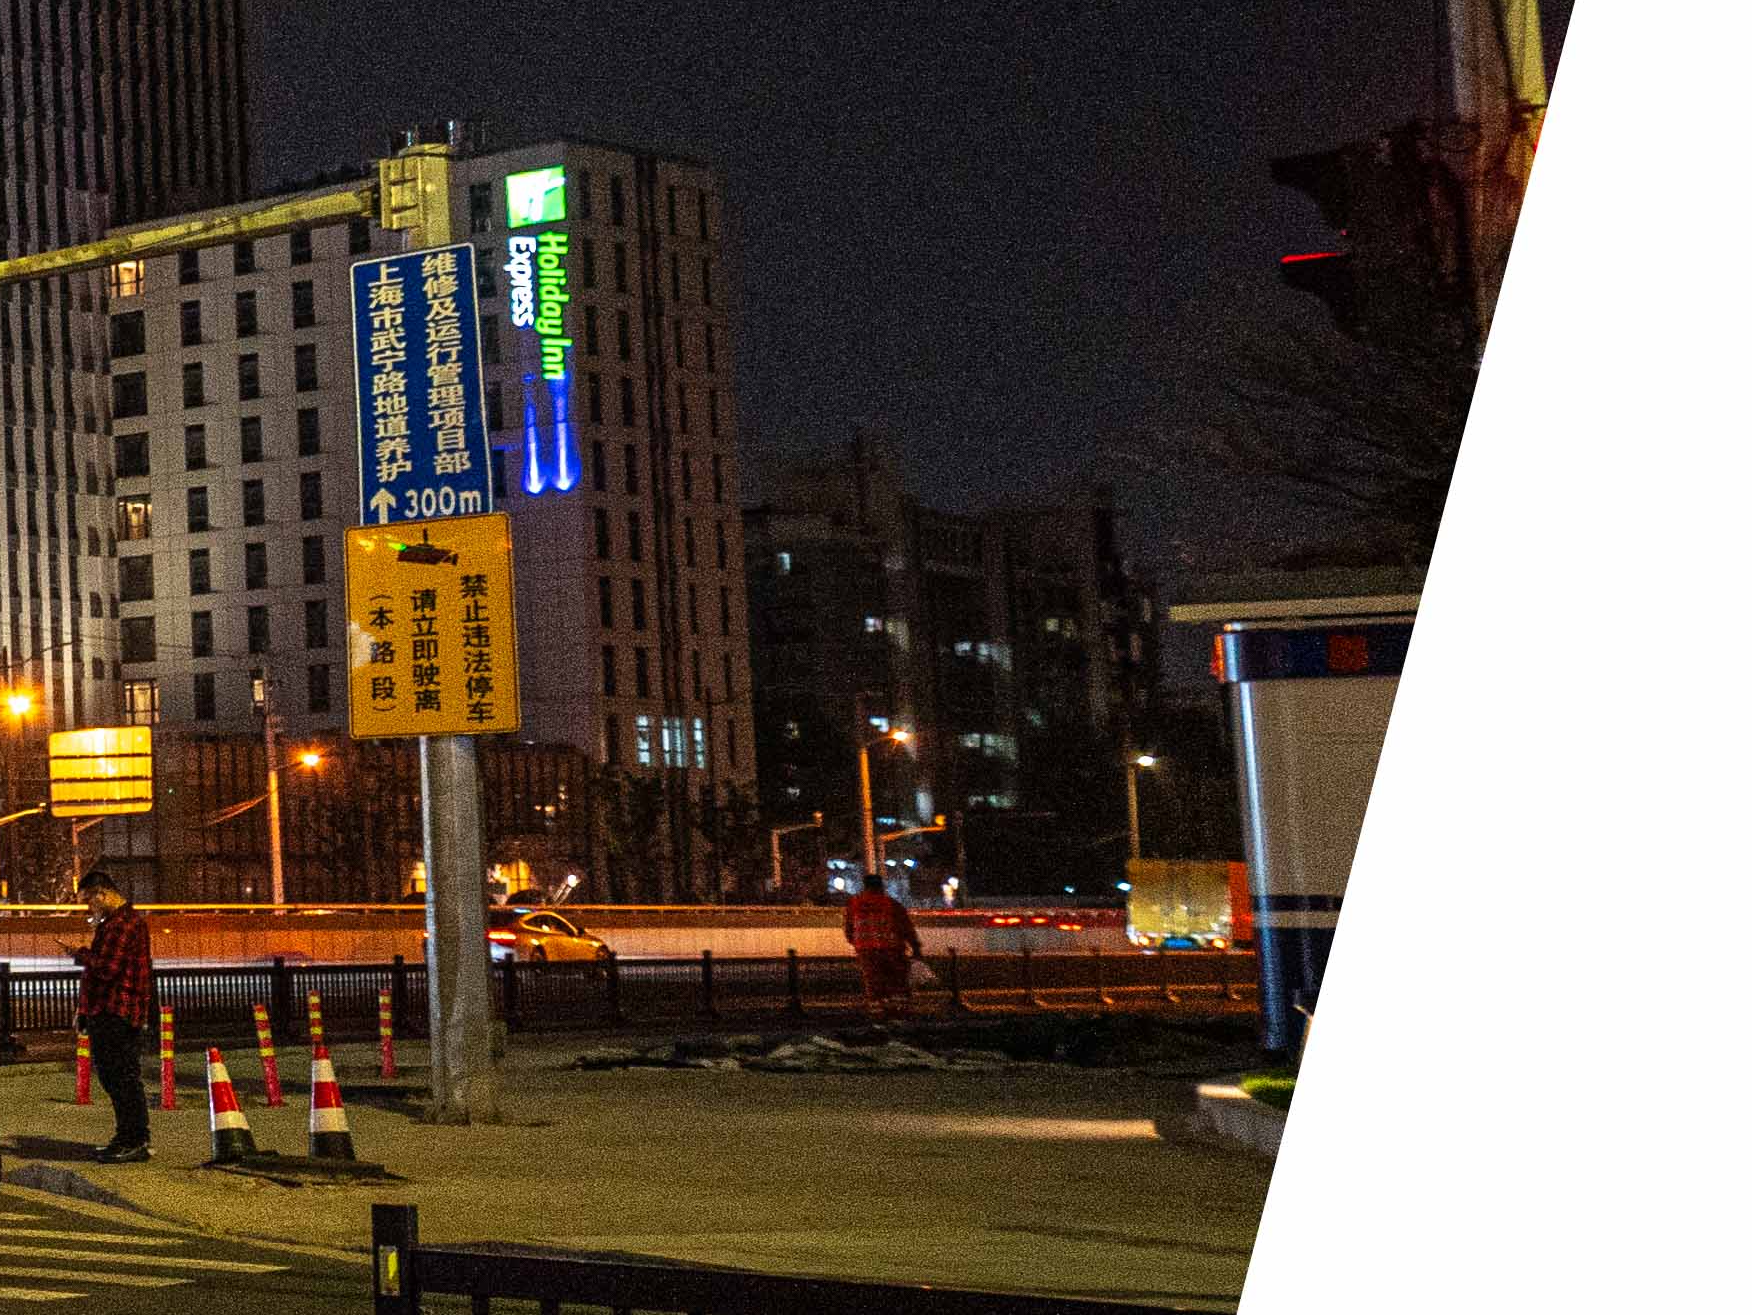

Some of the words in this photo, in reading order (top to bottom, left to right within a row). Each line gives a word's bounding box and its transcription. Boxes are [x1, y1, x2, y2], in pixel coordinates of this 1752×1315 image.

[504, 236, 536, 328] Express
[535, 231, 569, 335] Holiday
[368, 263, 412, 482] 上海市武宁路地道养护
[421, 252, 471, 475] 维修及运行管理项目部
[541, 337, 572, 380] Inn
[404, 485, 482, 518] 300m
[410, 588, 442, 713] 请立即驶离
[459, 573, 494, 723] 禁止违法停车
